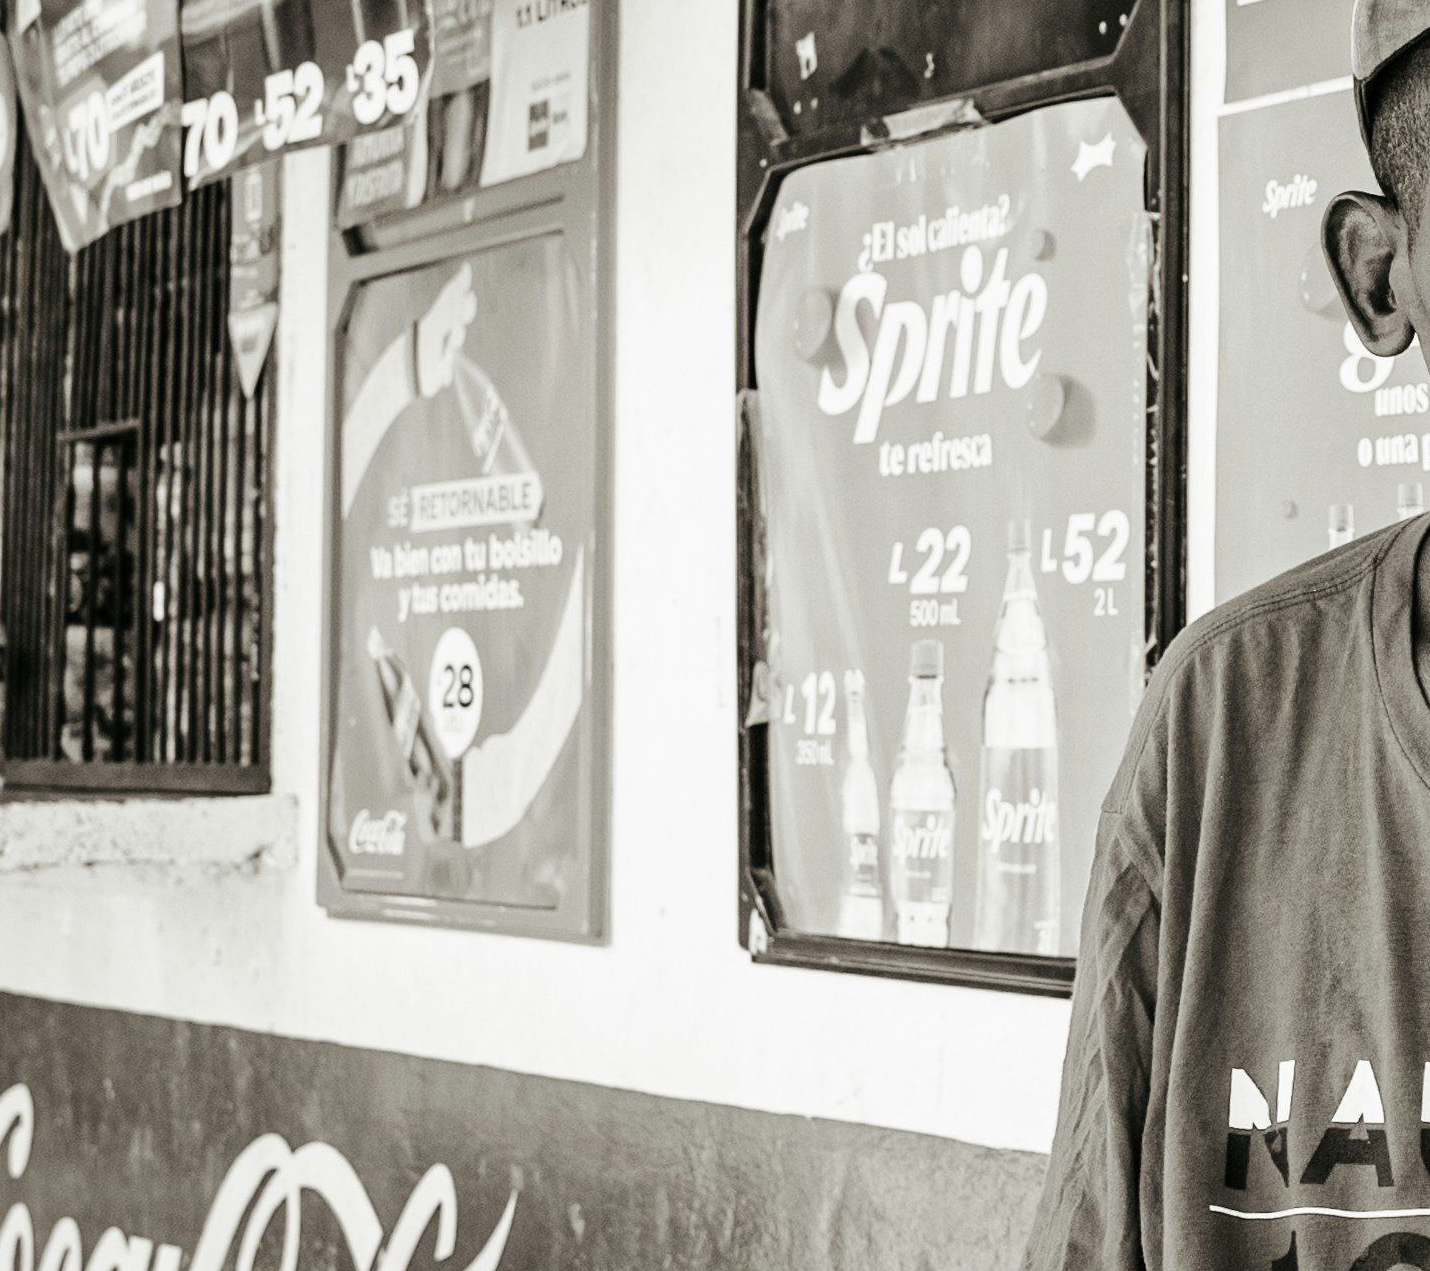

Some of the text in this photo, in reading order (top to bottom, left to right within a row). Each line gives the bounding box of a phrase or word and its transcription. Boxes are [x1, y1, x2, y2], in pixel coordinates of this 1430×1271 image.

[1262, 173, 1318, 219] Sprite
[857, 193, 1012, 273] ¿El sol calienta?
[818, 244, 1048, 445] Sprite
[1374, 384, 1430, 417] unos
[878, 430, 993, 477] te refresca
[1357, 435, 1418, 468] o una
[418, 481, 533, 522] RETORNABLE
[370, 528, 563, 580] Va bien con tu bolsillo
[396, 587, 412, 624] y
[411, 581, 439, 615] tus
[909, 599, 939, 627] 500
